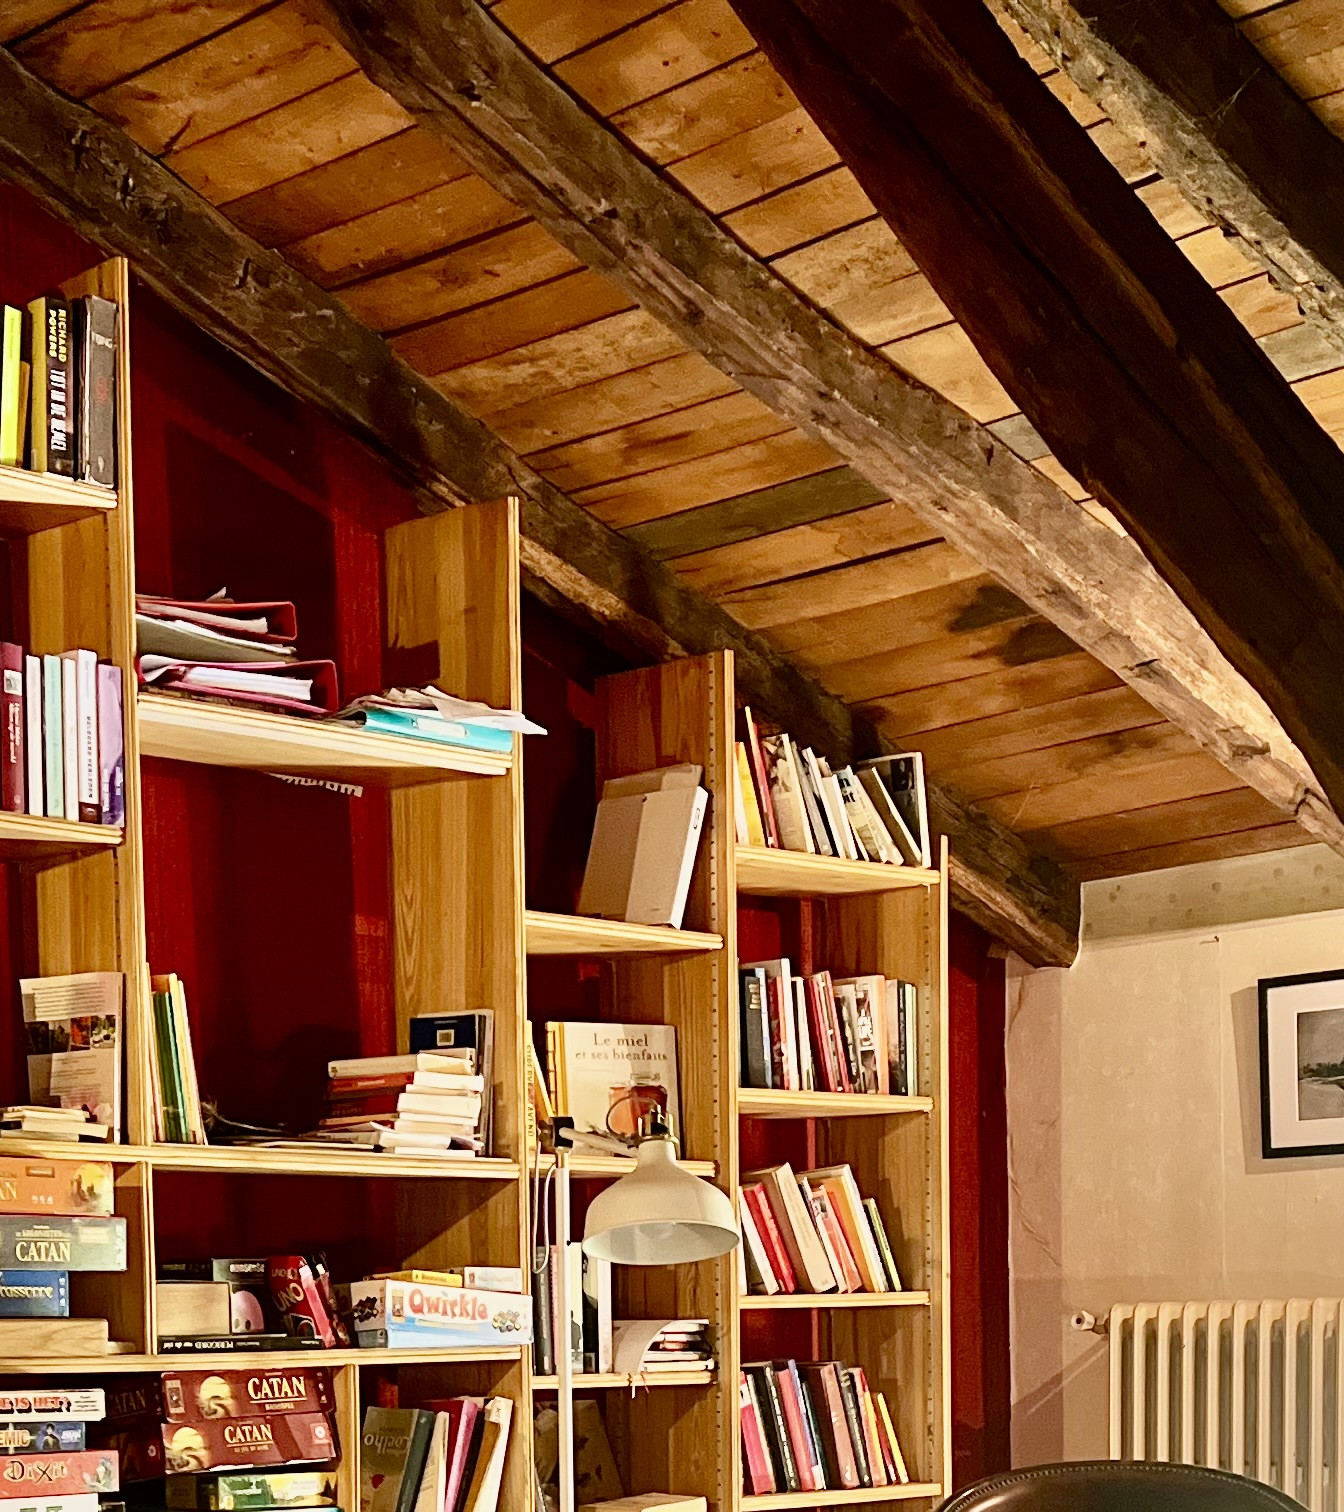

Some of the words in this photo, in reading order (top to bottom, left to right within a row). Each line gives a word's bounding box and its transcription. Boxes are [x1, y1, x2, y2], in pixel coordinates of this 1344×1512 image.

[49, 309, 57, 358] POWERS
[58, 309, 67, 362] RICHARD
[50, 369, 66, 389] TOT
[50, 390, 66, 401] IN
[51, 403, 66, 415] DE
[593, 1033, 611, 1046] Le
[616, 1034, 649, 1047] miel
[576, 1051, 586, 1060] et
[591, 1051, 609, 1060] ses
[613, 1048, 667, 1061] bienfaits
[16, 1241, 71, 1262] CATAN
[273, 1282, 305, 1311] UNO
[409, 1288, 488, 1320] Qwirkle
[248, 1376, 306, 1400] CATAN
[13, 1398, 32, 1413] IS
[33, 1397, 72, 1413] HET?
[224, 1424, 273, 1444] CATAN
